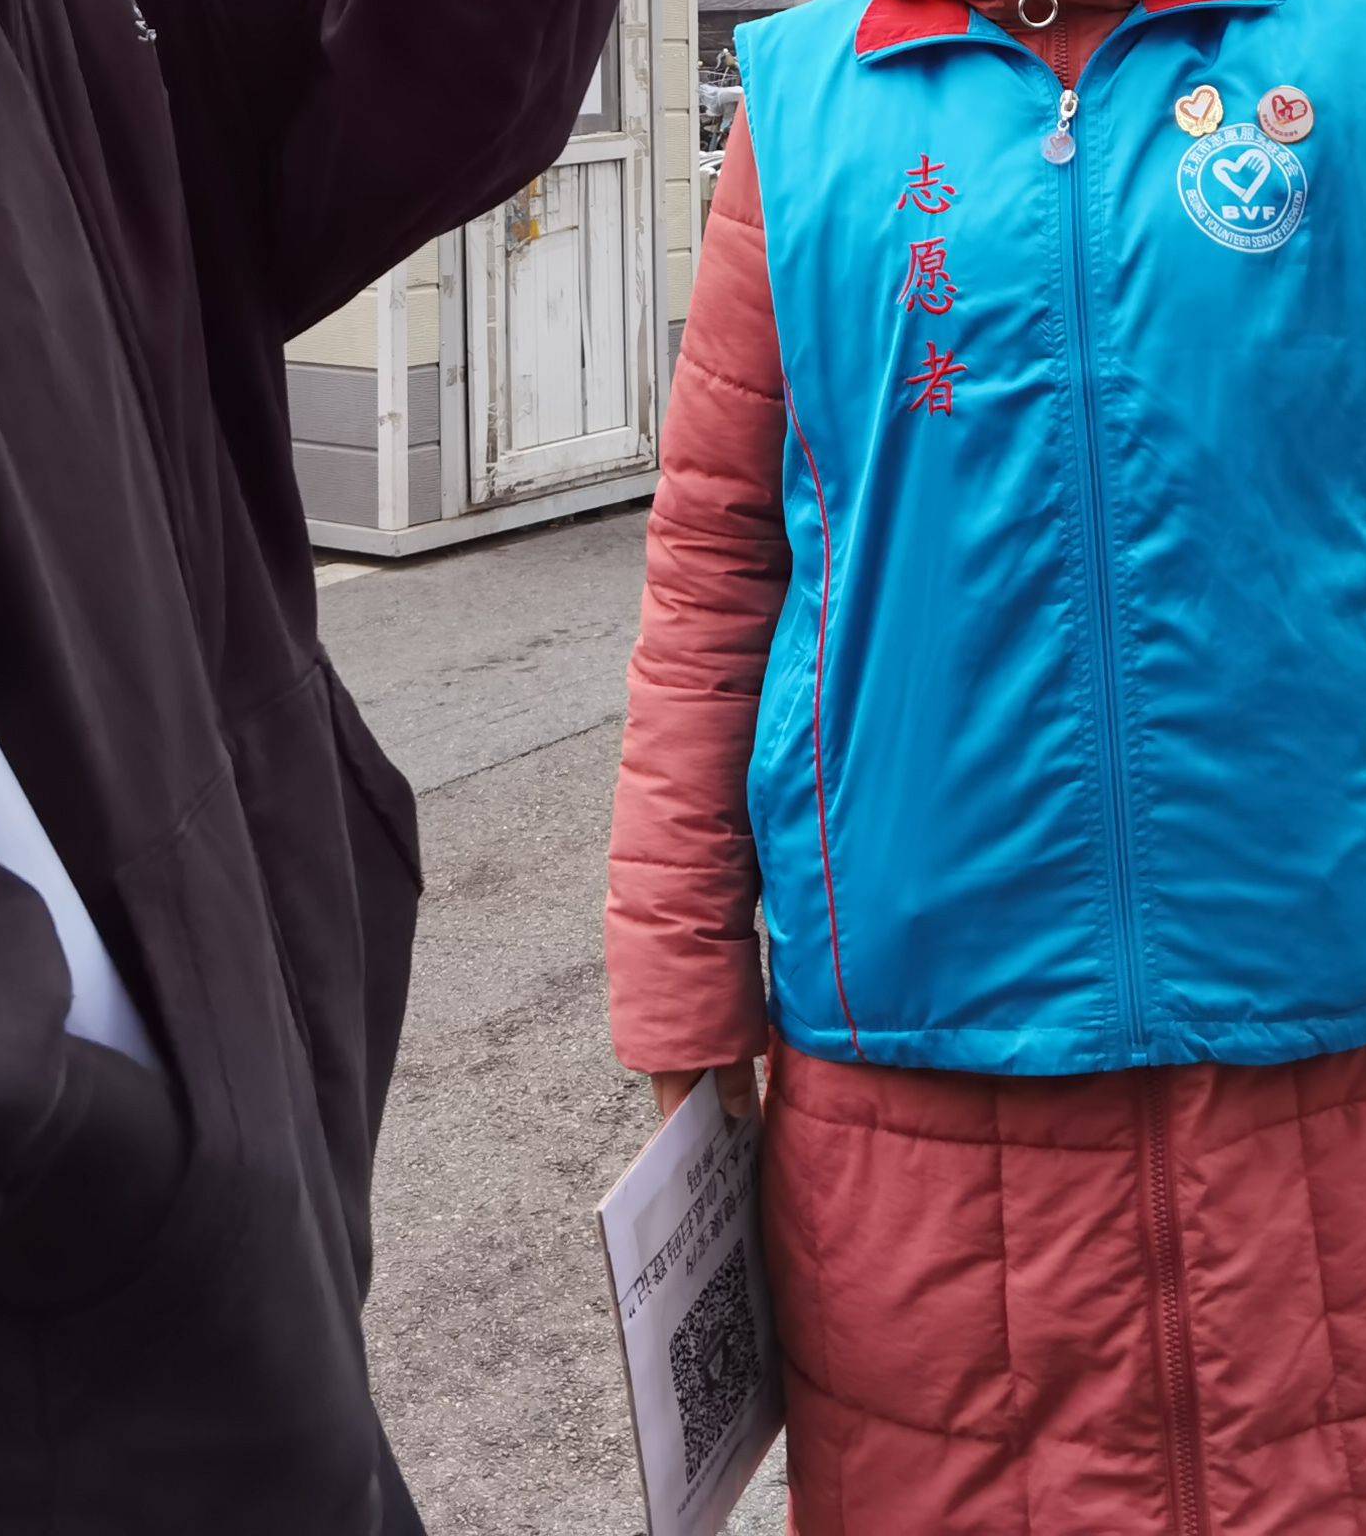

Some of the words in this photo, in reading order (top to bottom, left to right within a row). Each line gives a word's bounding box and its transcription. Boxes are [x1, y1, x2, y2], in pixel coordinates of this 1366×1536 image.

[1221, 205, 1276, 221] BVF
[1205, 216, 1251, 247] VOLUNTEER
[1252, 230, 1283, 247] SERVICE
[896, 153, 968, 417] 志愿者
